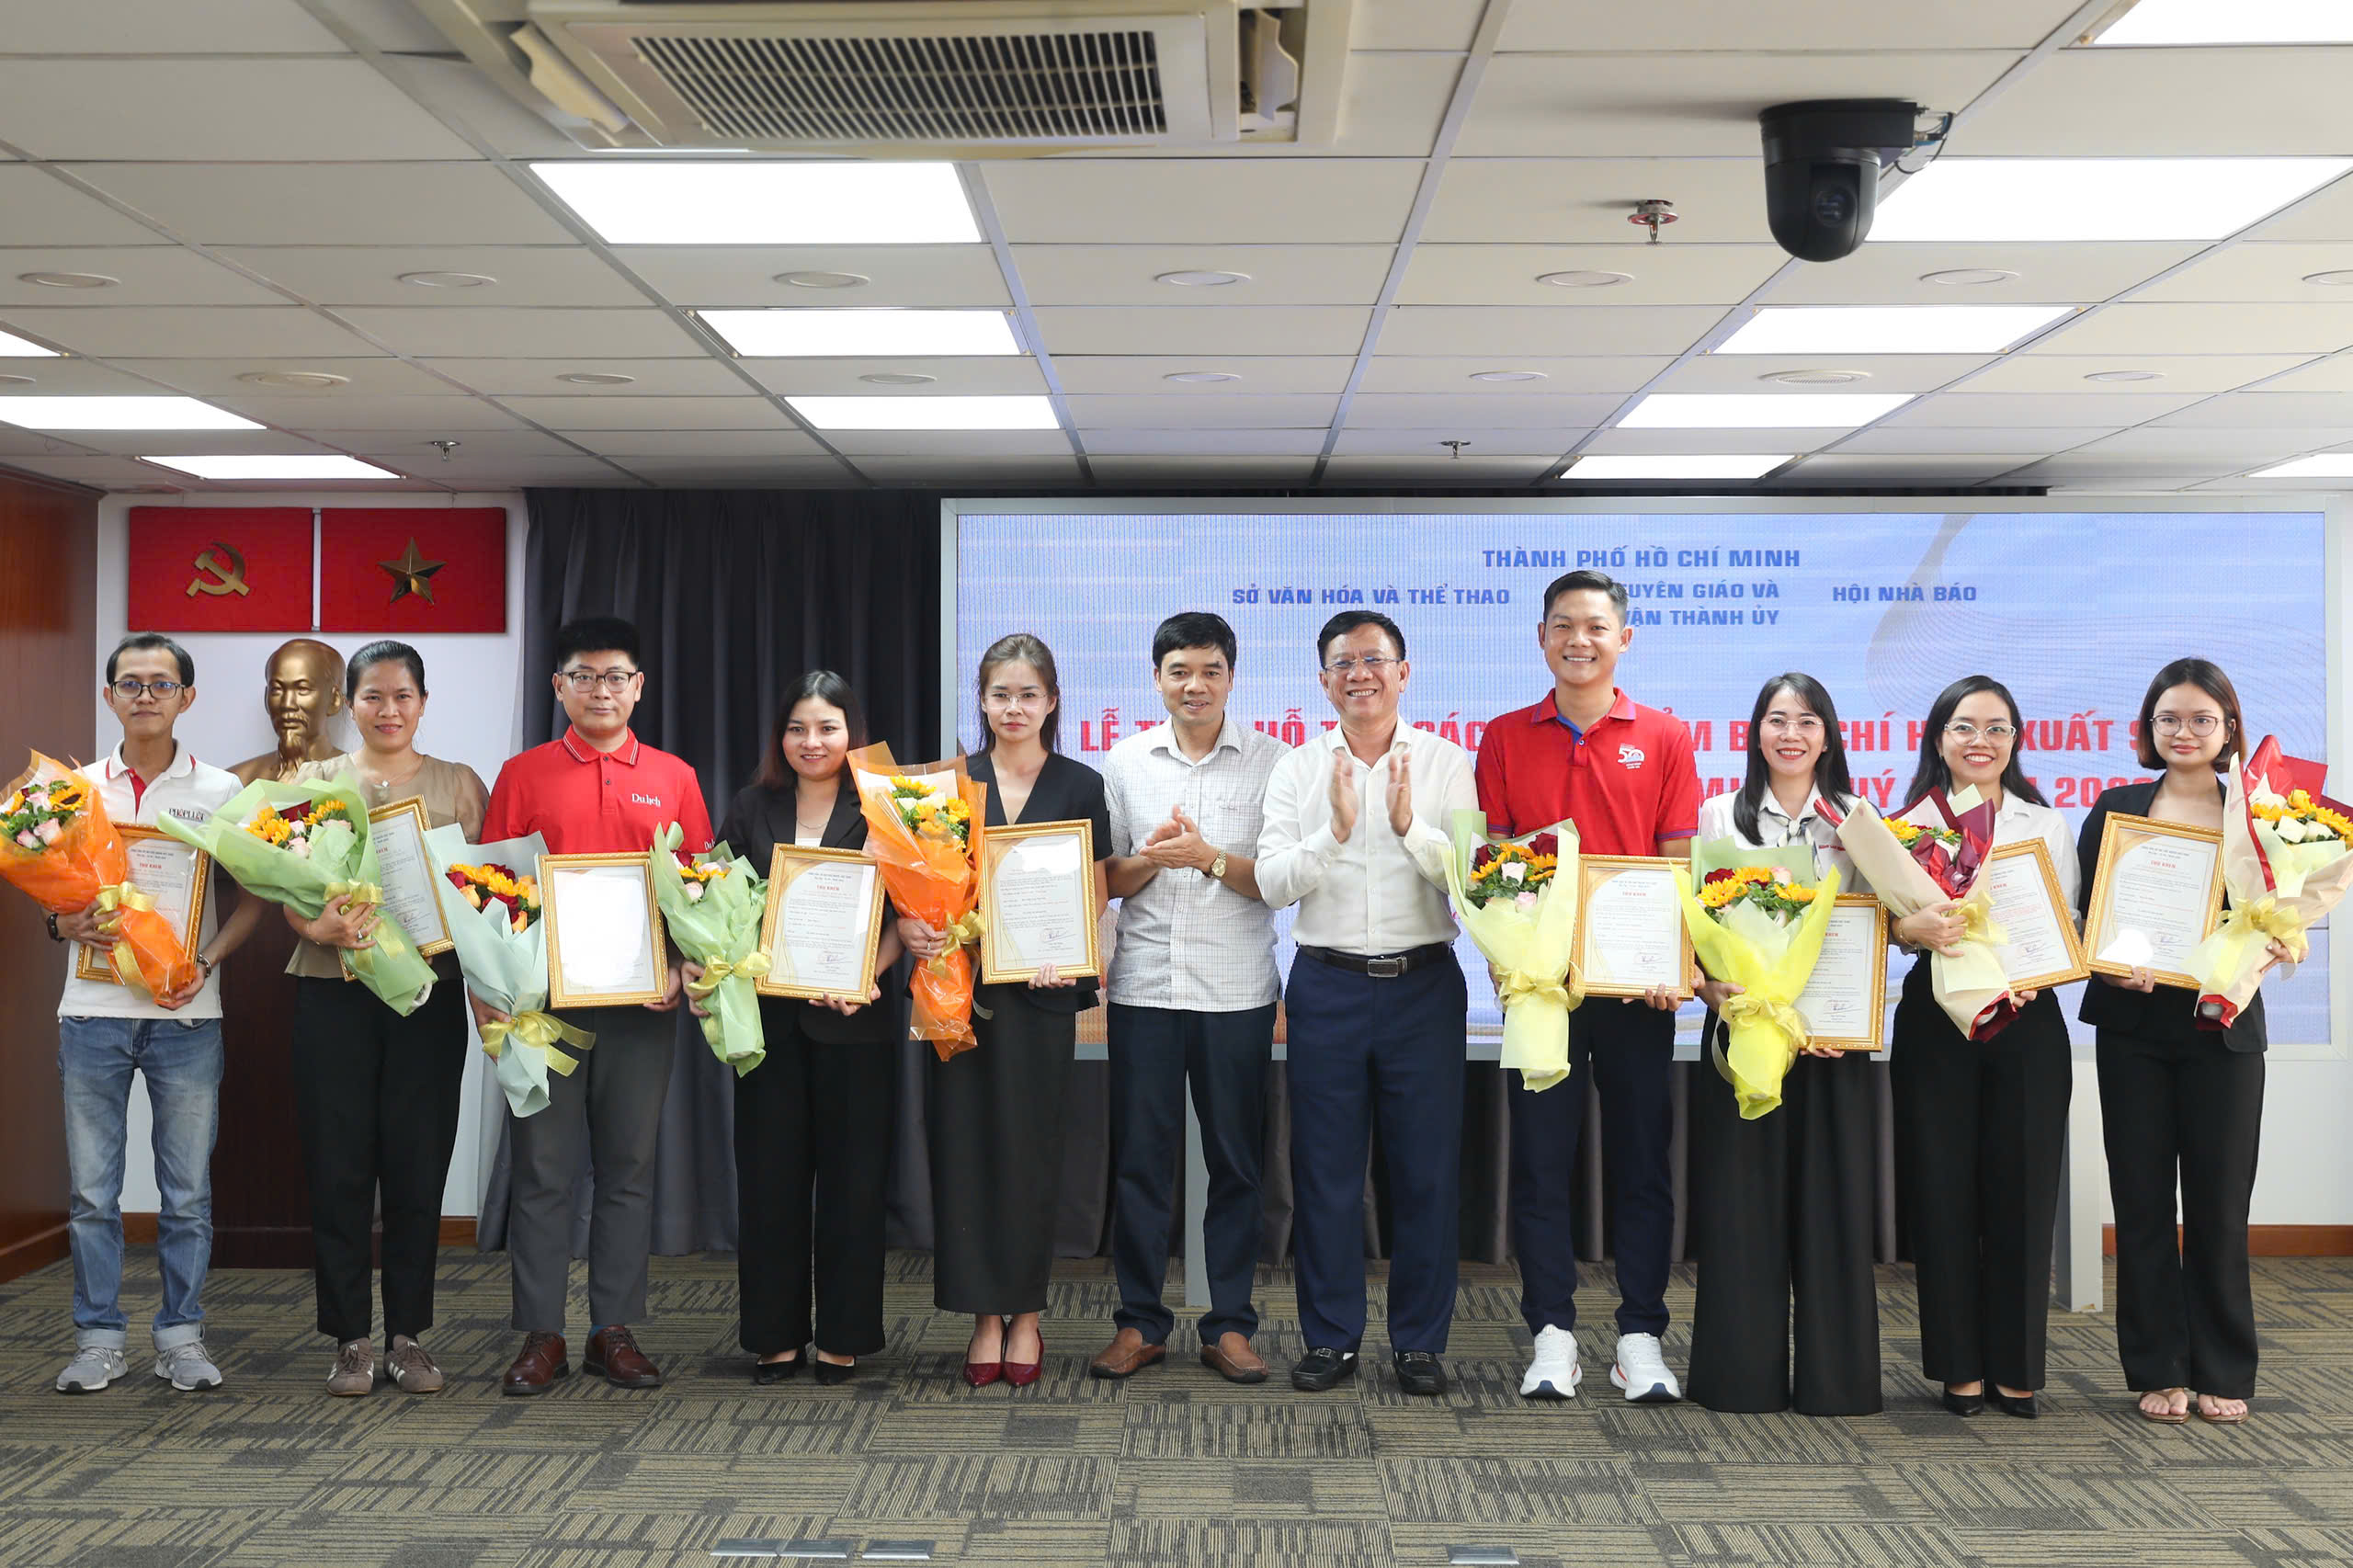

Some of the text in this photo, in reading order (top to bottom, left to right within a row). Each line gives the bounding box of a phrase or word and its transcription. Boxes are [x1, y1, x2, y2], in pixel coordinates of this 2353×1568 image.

[1483, 545, 1800, 567] THÀNH PHỐ HỒ CHÍ MINH
[1233, 583, 1510, 605] SỞ VĂN HÓA VÀ THỂ THAO
[1693, 580, 1745, 598] GIÁO
[1752, 579, 1779, 597] VÀ
[1833, 582, 1976, 603] HỘI NHÀ BÁO
[1669, 606, 1743, 625] THÀNH
[1753, 605, 1779, 625] ỦY
[1080, 708, 1120, 751] LỄ
[2018, 710, 2113, 751] XUẤT
